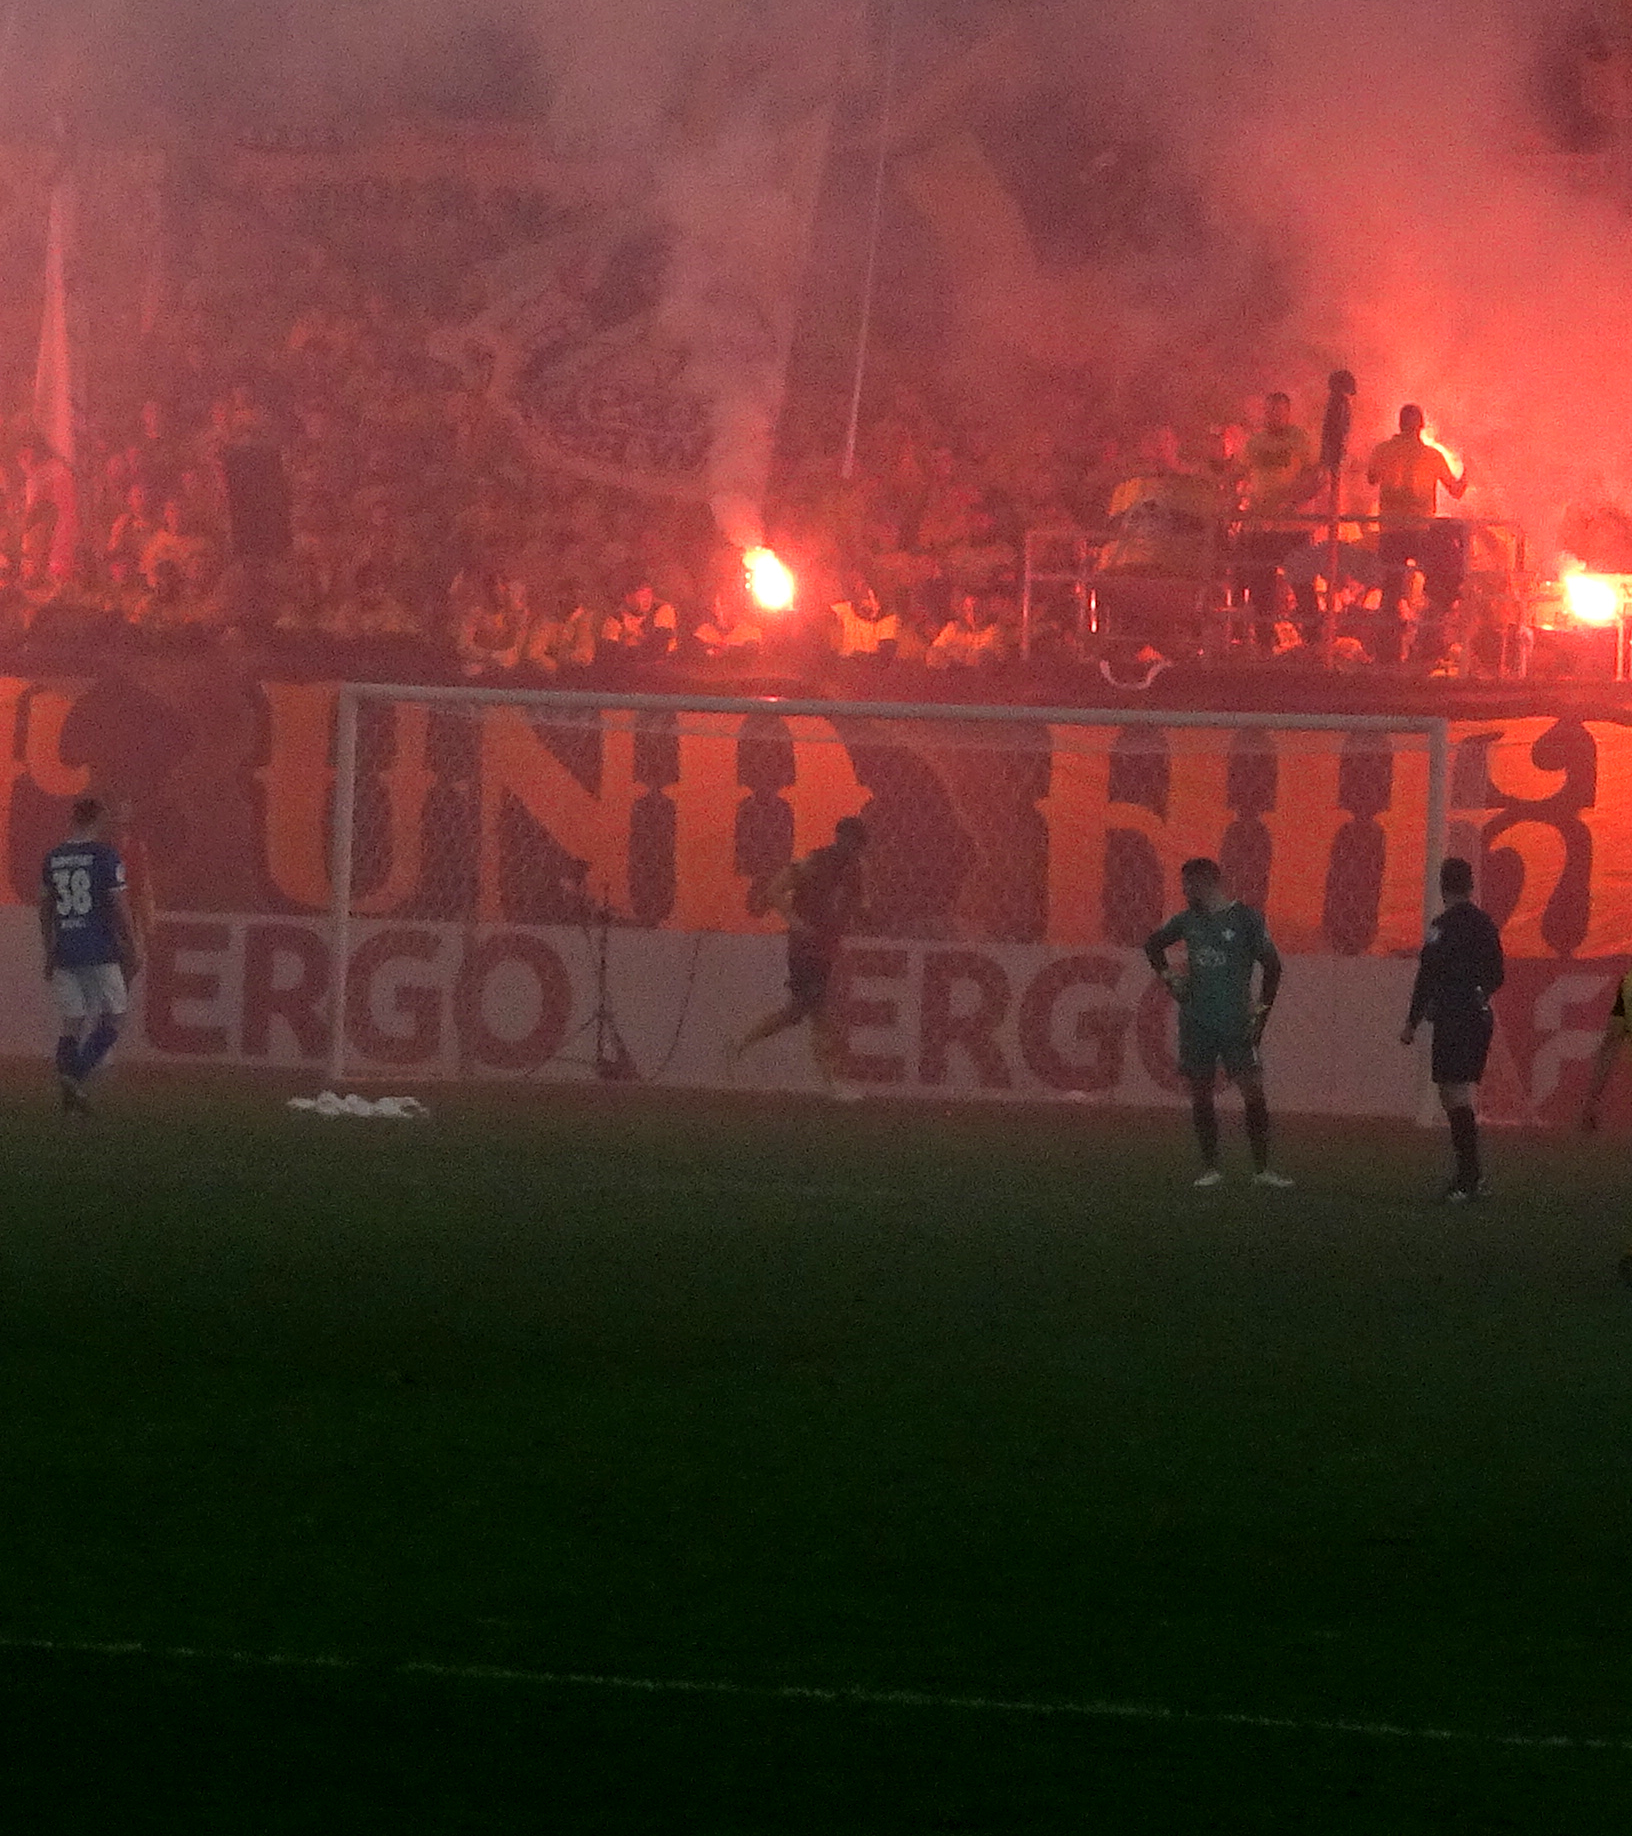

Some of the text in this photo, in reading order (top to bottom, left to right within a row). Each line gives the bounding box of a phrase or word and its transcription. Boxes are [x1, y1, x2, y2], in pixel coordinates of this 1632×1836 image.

[251, 679, 876, 935] UND
[52, 867, 92, 915] 38
[145, 924, 571, 1070] ERGO
